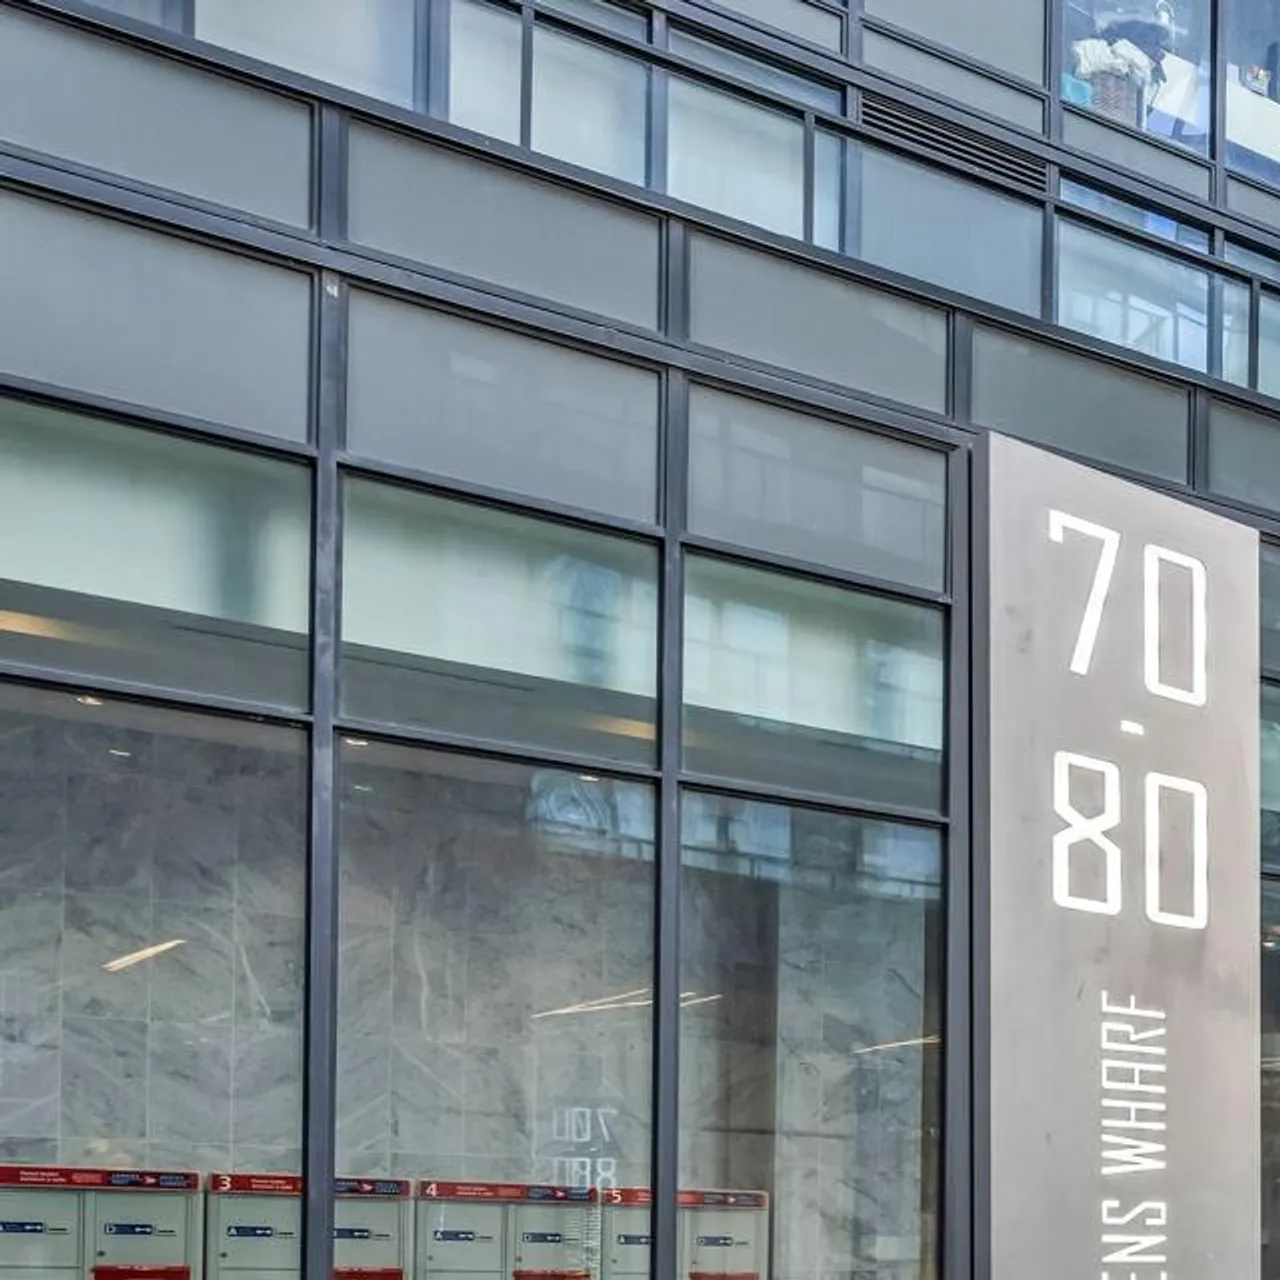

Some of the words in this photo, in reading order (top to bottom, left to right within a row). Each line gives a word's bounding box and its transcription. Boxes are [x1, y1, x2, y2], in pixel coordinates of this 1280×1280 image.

[1048, 509, 1207, 706] 70
[1052, 750, 1208, 930] 80
[1101, 990, 1167, 1176] WHARF
[218, 1176, 232, 1192] 3
[425, 1183, 437, 1197] 4
[611, 1189, 622, 1203] 5
